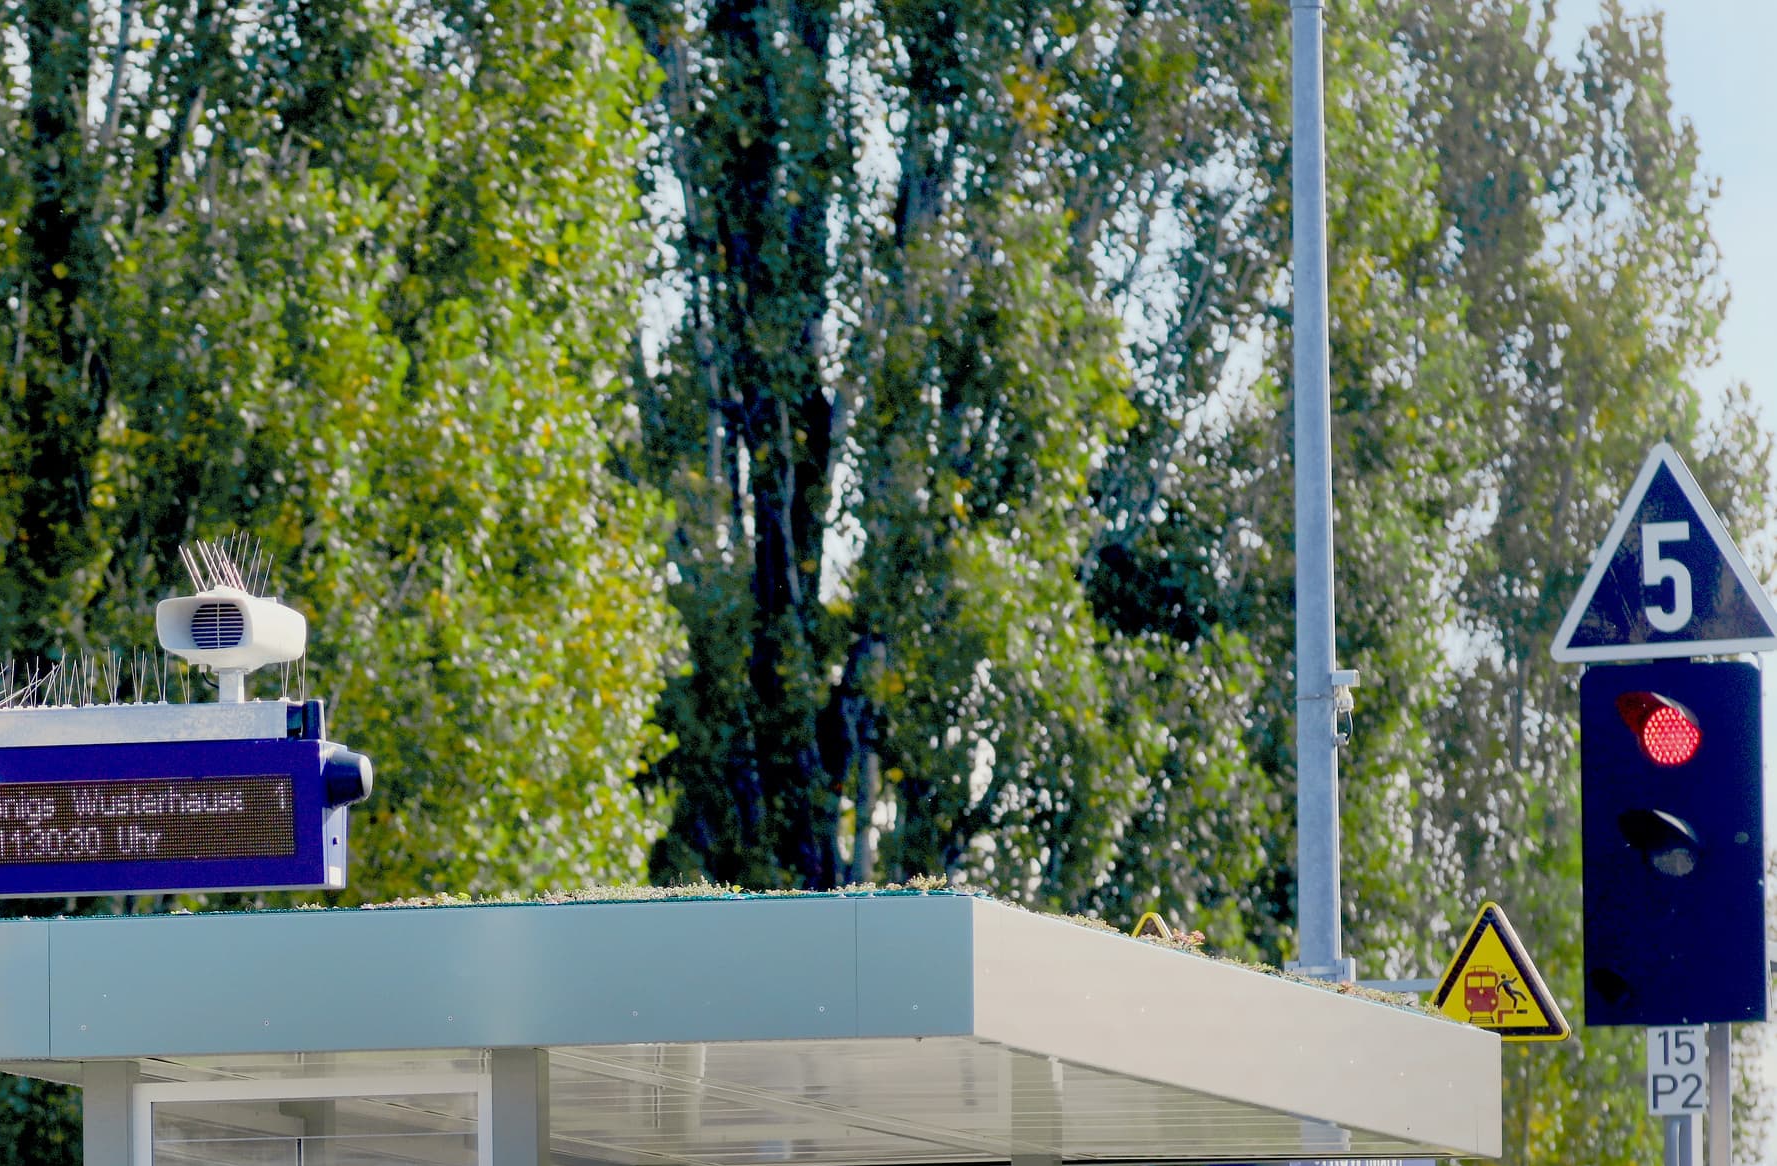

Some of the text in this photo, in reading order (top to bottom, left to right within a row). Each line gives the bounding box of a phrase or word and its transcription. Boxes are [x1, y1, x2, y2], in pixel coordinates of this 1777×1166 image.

[1642, 521, 1692, 633] 5
[274, 781, 285, 810] 1
[118, 825, 162, 854] Uhr
[1658, 1029, 1696, 1067] 15
[1652, 1073, 1703, 1109] P2
